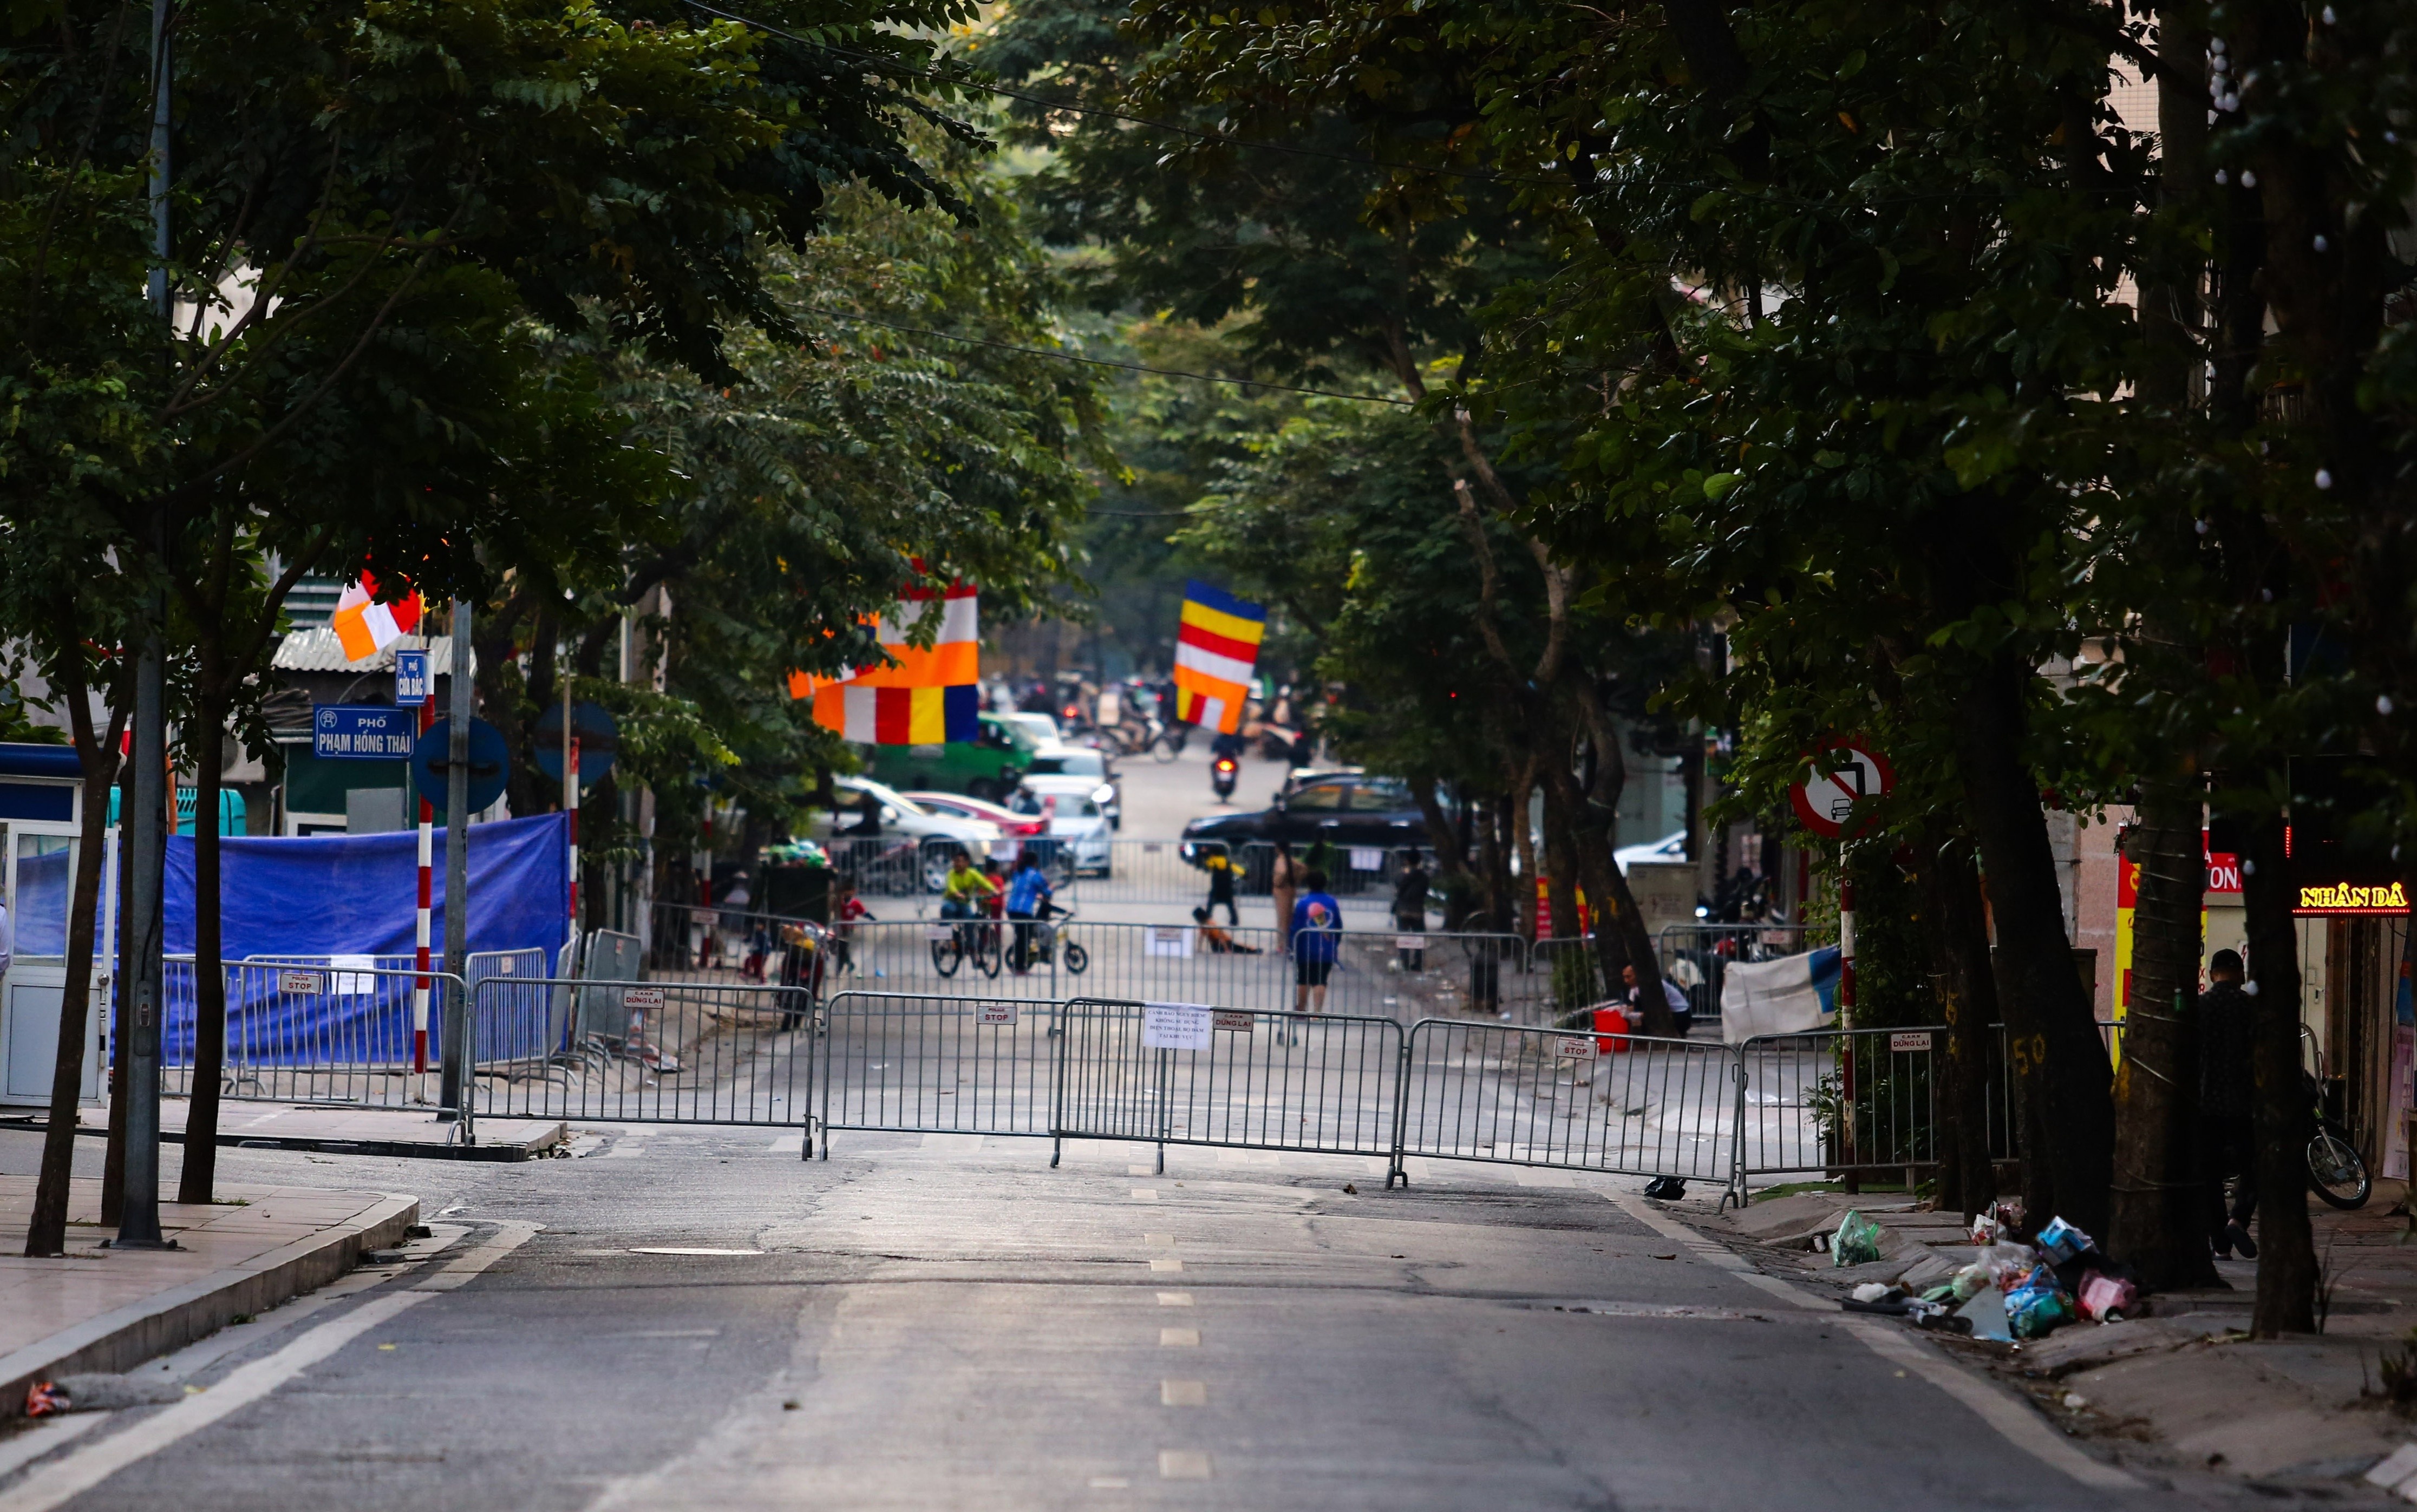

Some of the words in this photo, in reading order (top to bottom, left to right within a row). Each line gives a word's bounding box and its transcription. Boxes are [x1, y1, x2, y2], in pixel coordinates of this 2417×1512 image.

[358, 716, 387, 728] PHỐ
[319, 734, 350, 754] PHẠM
[354, 730, 383, 752] HỒNG
[387, 731, 410, 752] THÁI
[2301, 882, 2370, 907] NHÂN
[2372, 882, 2408, 907] DÂ
